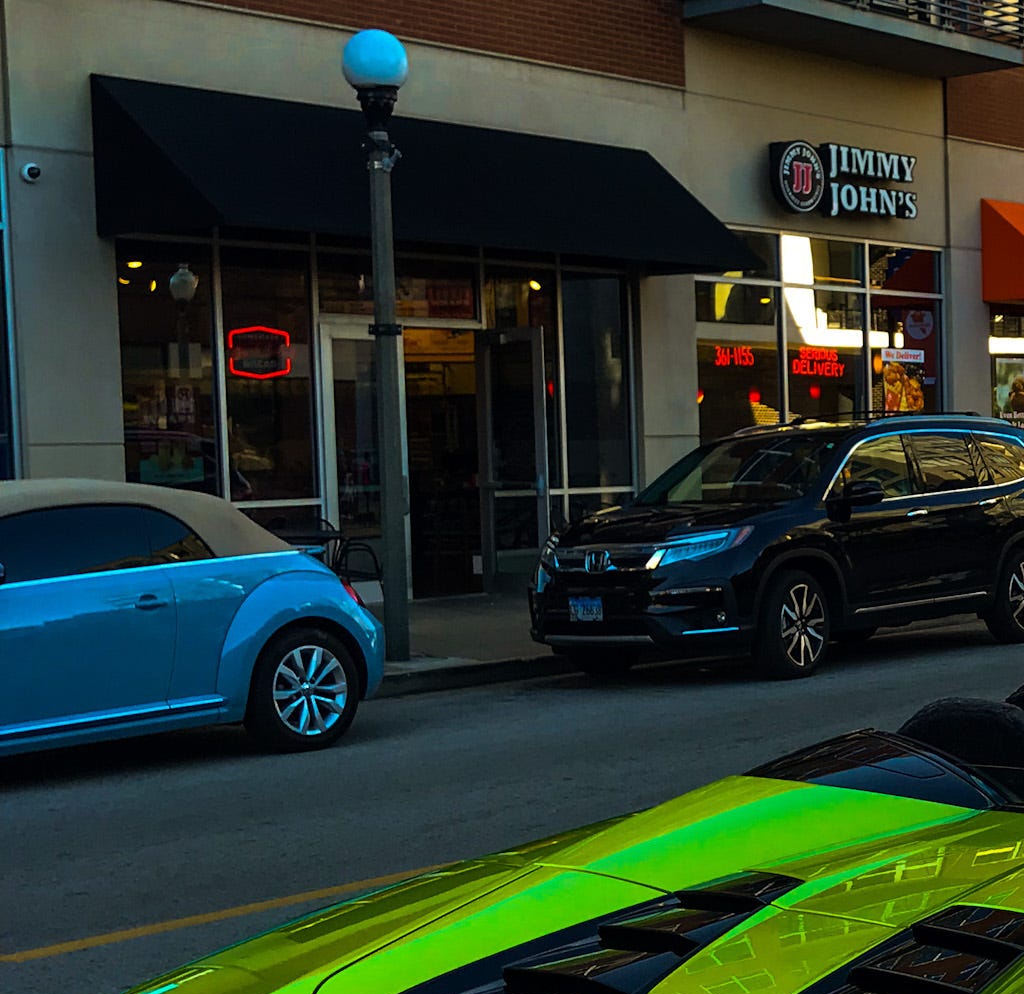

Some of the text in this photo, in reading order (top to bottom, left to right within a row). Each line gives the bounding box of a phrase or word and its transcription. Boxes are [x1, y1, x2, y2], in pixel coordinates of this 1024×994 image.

[793, 161, 812, 194] JJ
[829, 143, 916, 182] JIMMY
[830, 182, 917, 218] JOHN'S
[714, 345, 755, 366] 361-1155
[792, 360, 845, 377] DELIVERY
